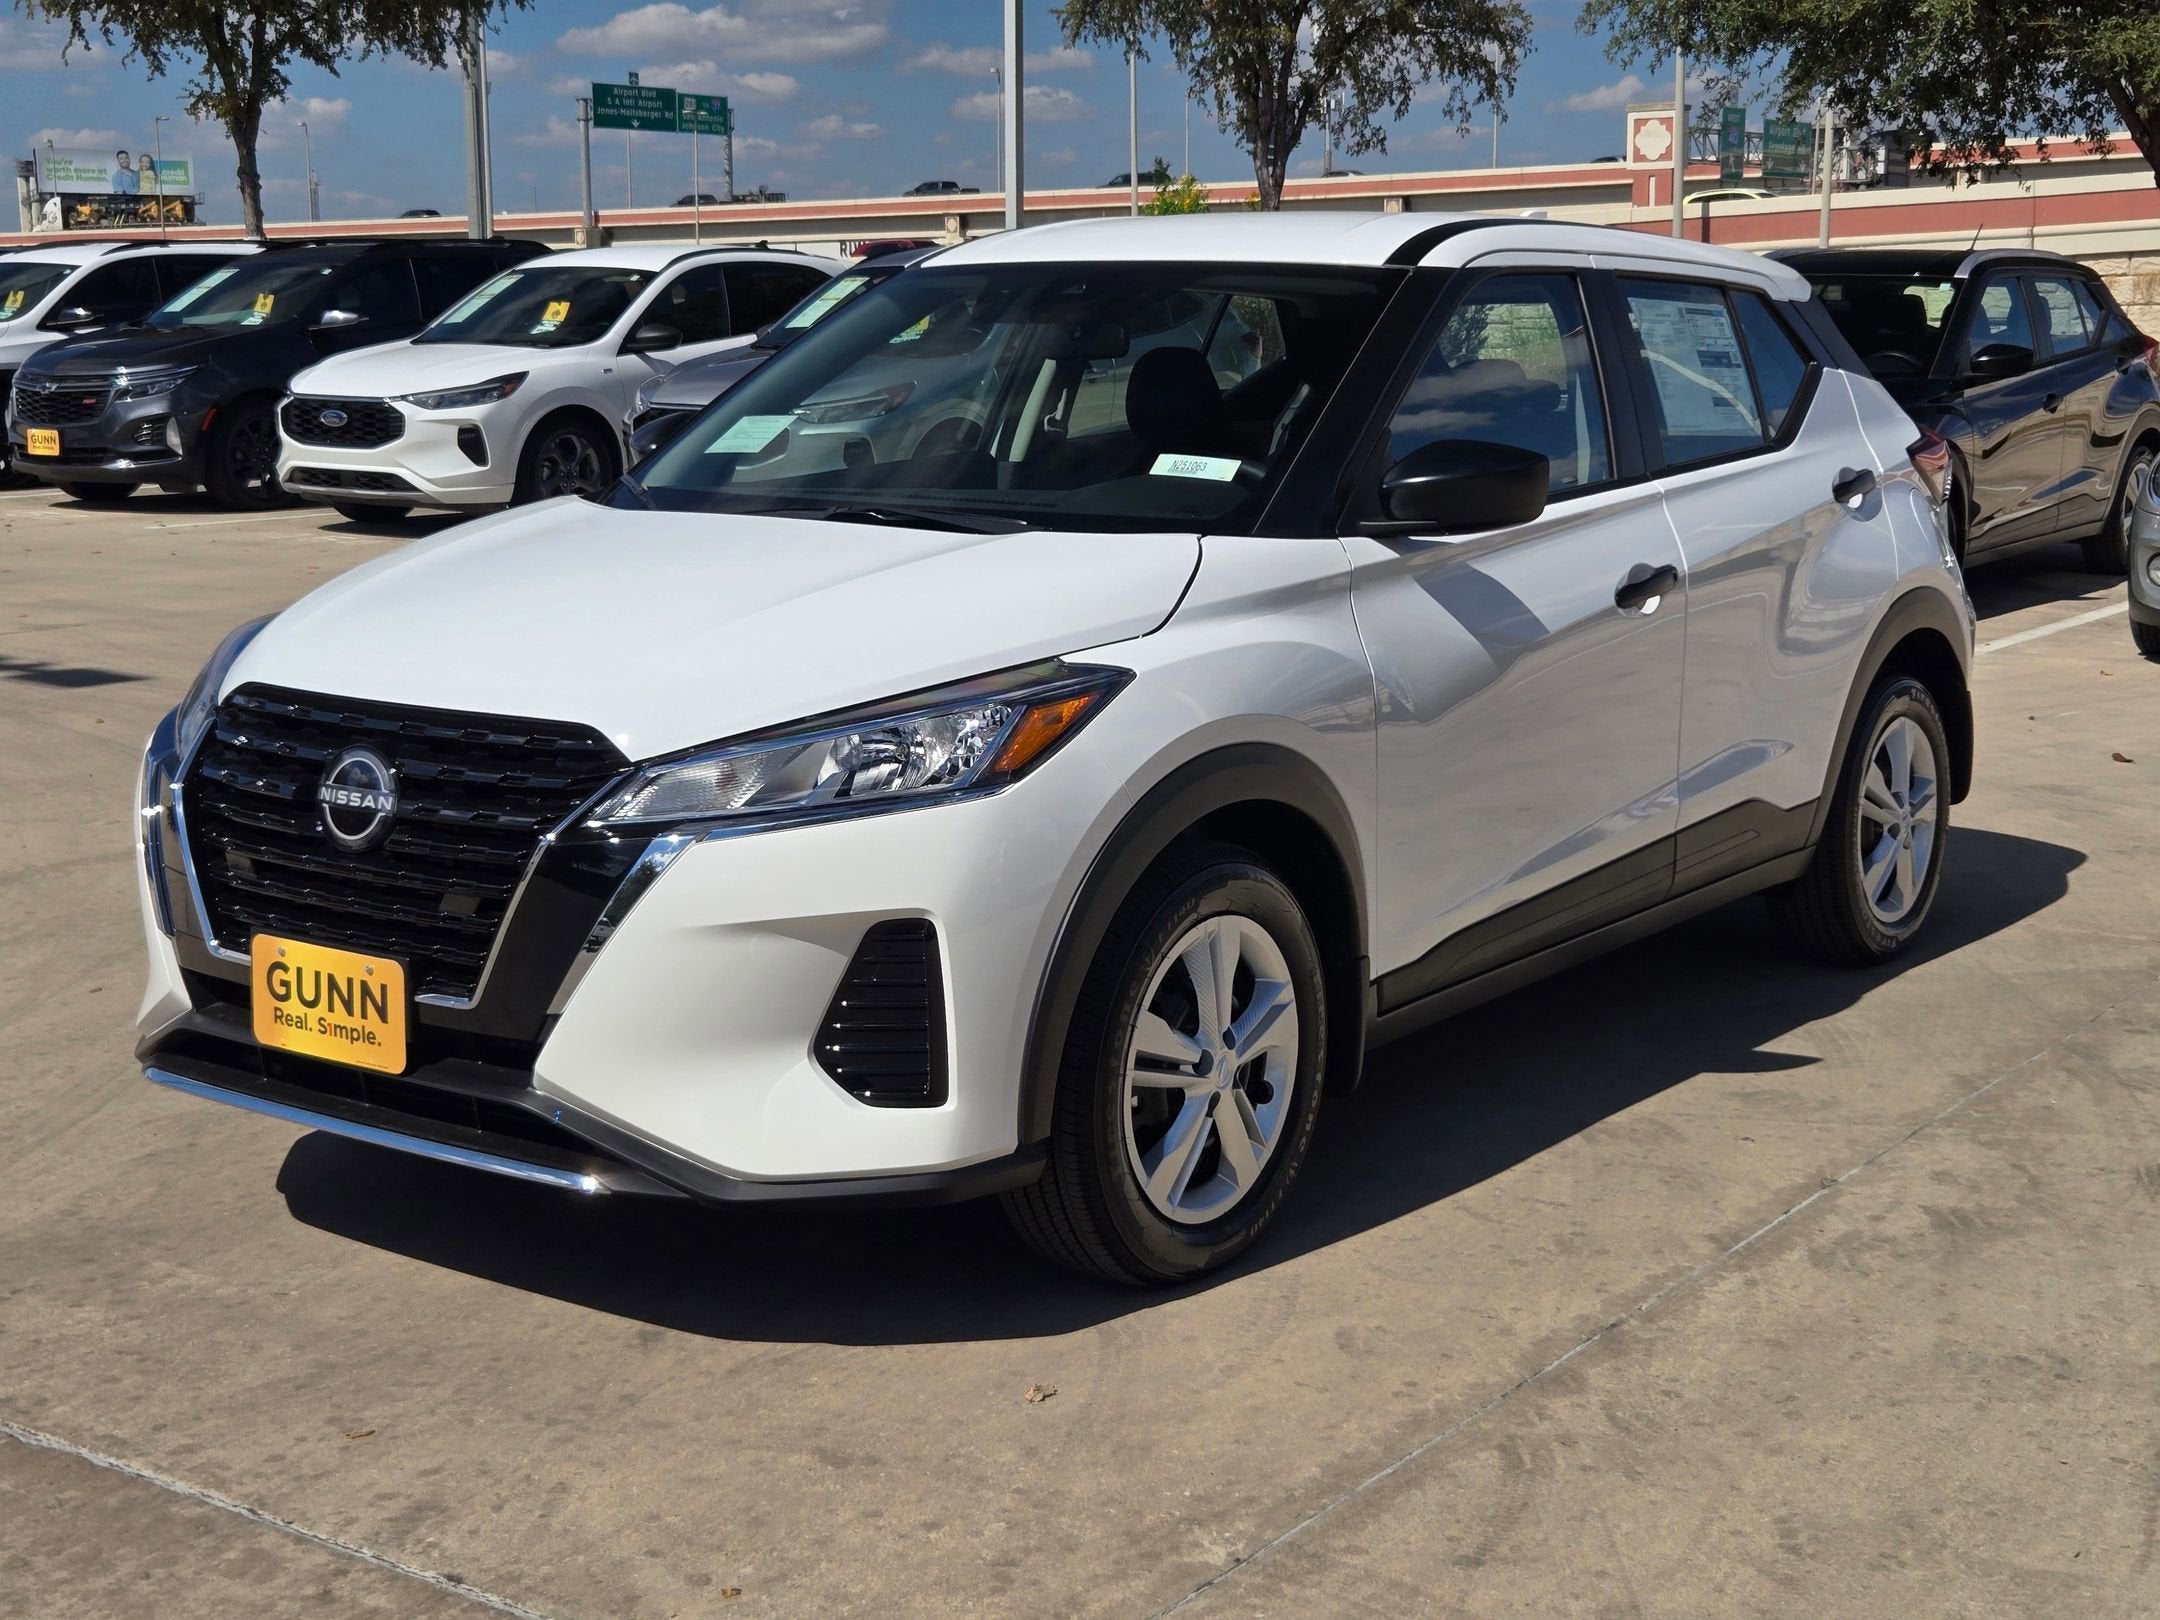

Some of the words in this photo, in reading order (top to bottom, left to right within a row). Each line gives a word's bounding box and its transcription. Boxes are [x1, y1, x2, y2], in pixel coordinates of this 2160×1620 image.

[613, 88, 639, 97] Airport
[642, 89, 656, 98] Blvd
[638, 100, 663, 109] Airport
[665, 111, 674, 119] Rd
[712, 124, 726, 134] City
[31, 435, 56, 445] GUNN
[320, 787, 393, 810] NISSAN
[266, 961, 389, 1024] GUNN
[274, 1006, 313, 1032] Real.
